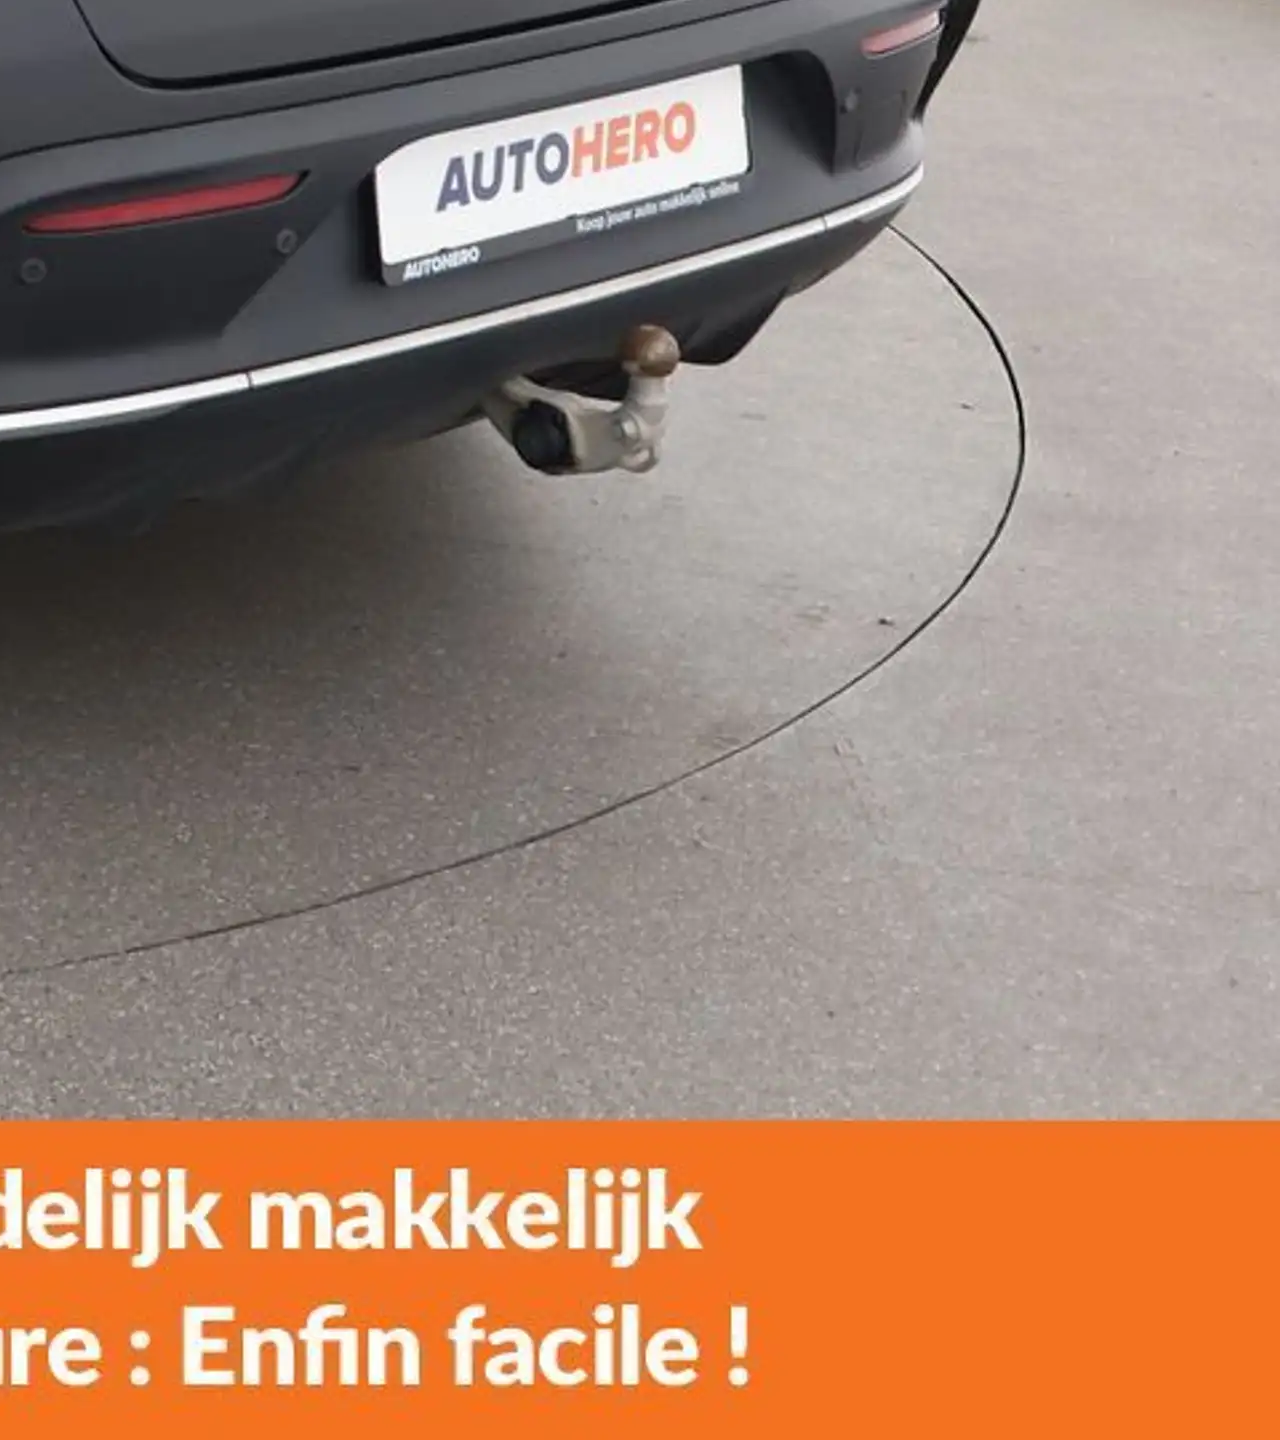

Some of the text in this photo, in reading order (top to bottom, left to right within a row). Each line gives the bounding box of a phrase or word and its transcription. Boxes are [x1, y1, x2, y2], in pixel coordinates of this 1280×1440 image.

[436, 102, 695, 212] AUTOHERO
[576, 215, 605, 232] Koop
[403, 245, 480, 281] AUTOHERO
